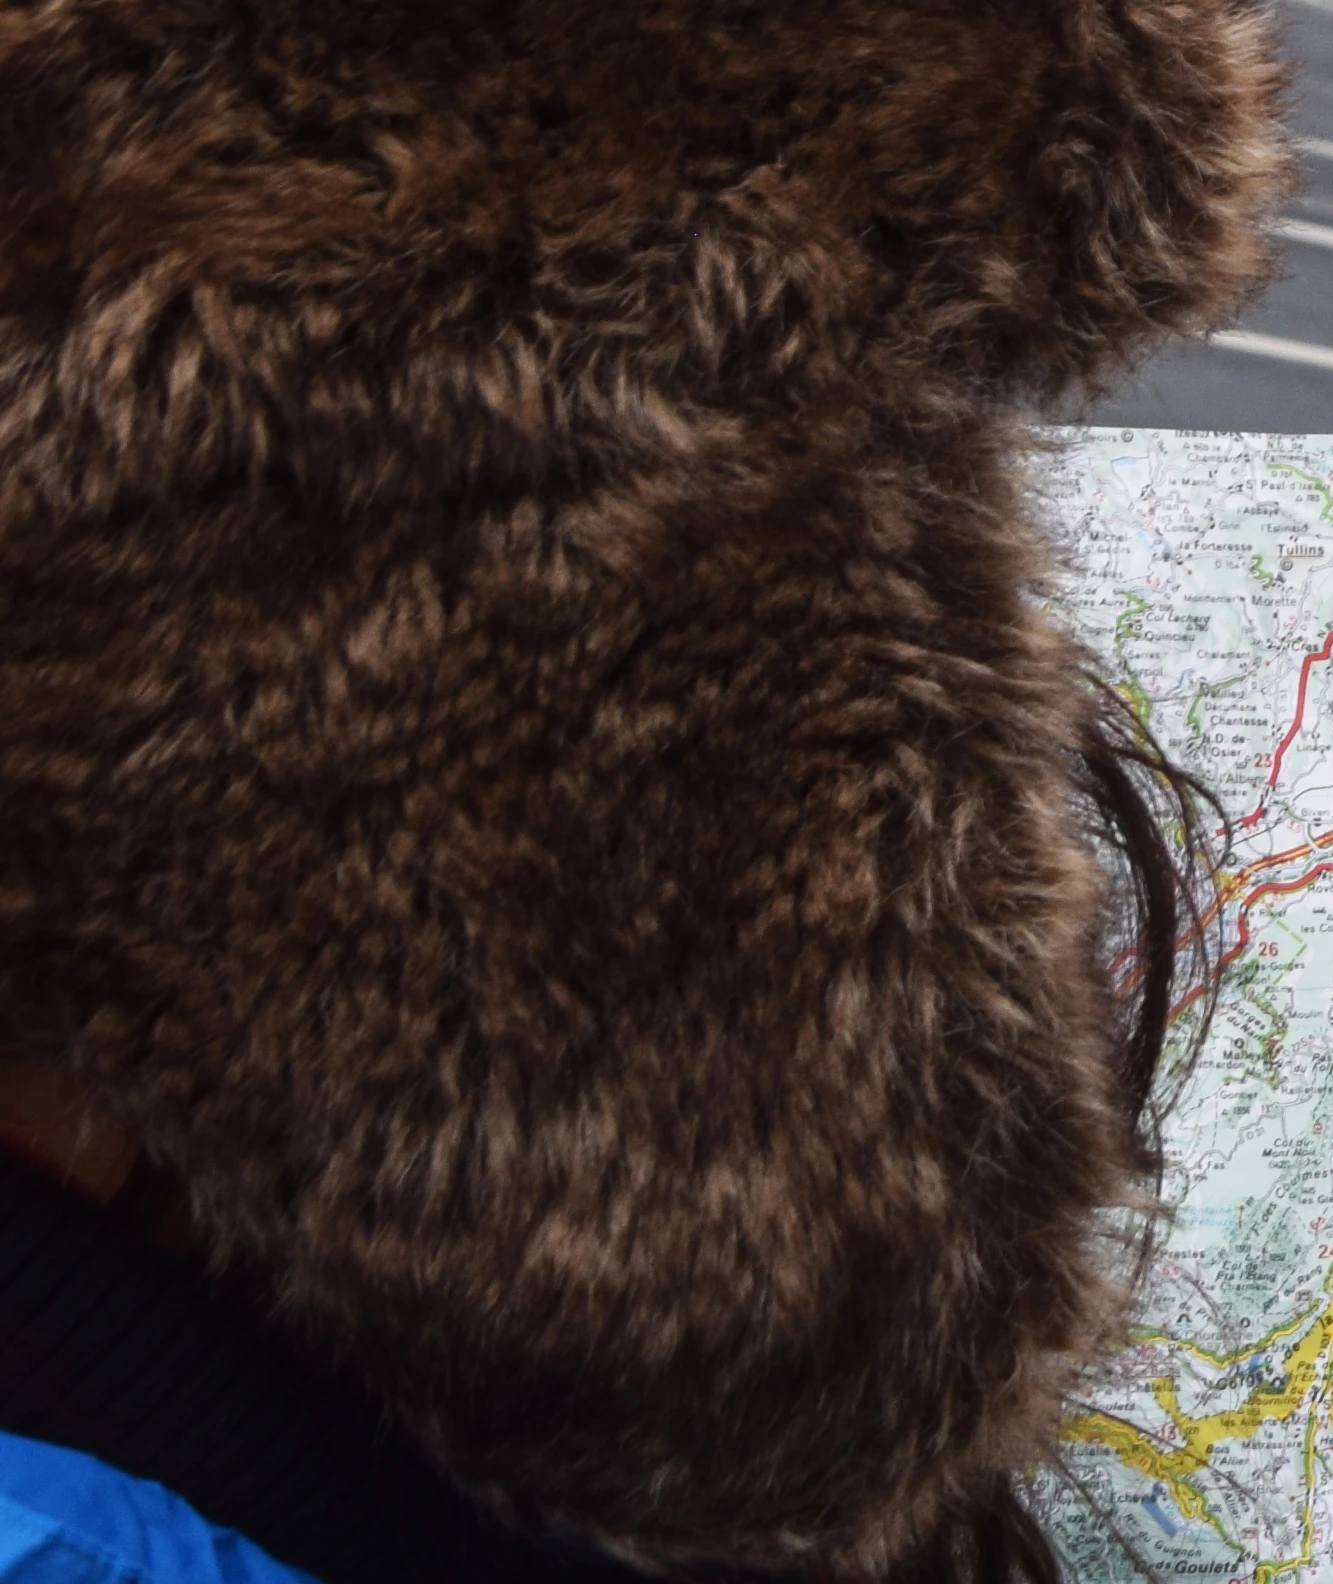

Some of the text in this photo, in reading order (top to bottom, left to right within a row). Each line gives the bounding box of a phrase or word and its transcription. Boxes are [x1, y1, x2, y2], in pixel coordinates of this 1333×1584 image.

[1278, 543, 1324, 557] Tullins
[1255, 753, 1272, 767] 23
[1259, 942, 1278, 955] 26
[1175, 1560, 1238, 1574] Goulets
